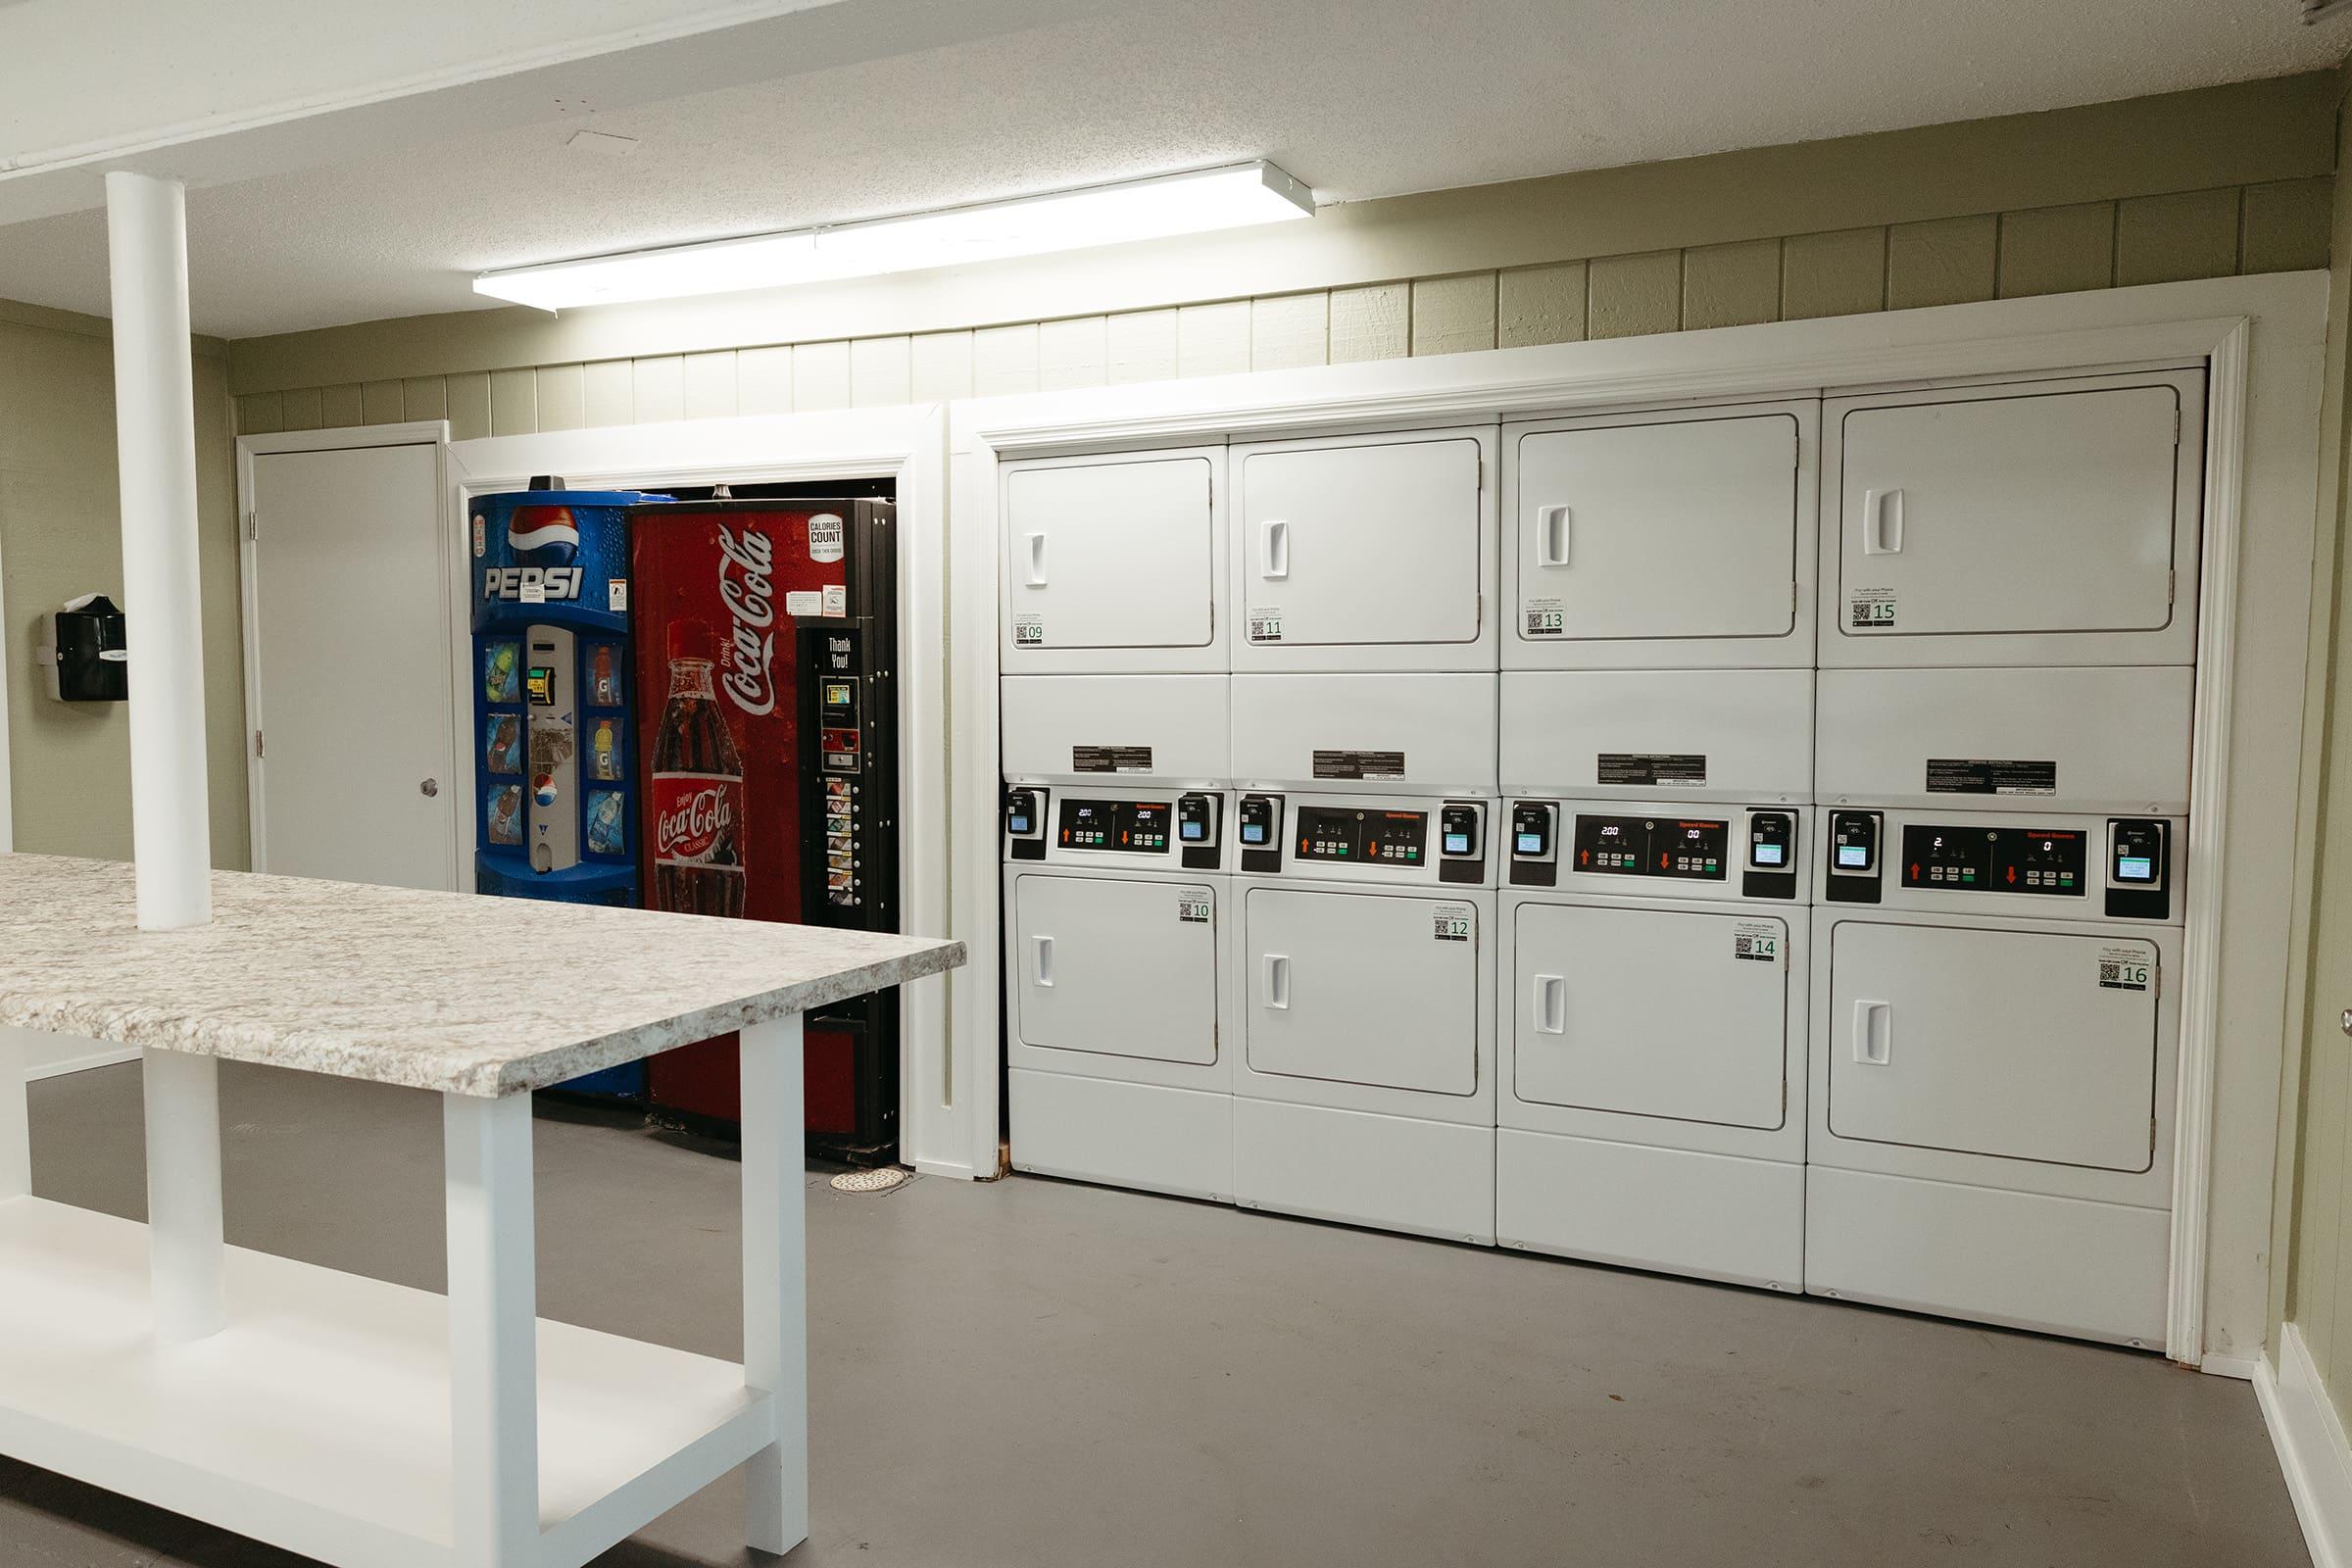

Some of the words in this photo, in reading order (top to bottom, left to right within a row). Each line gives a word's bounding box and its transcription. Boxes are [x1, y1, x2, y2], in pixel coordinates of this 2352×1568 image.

[810, 521, 841, 531] CALORIES
[810, 531, 841, 543] COUNT
[484, 567, 583, 599] PEPSI
[1874, 604, 1894, 618] 15
[717, 523, 775, 715] Coca-Cola
[1544, 613, 1562, 627] 13
[1029, 626, 1043, 638] 09
[1266, 621, 1282, 634] 11
[829, 637, 851, 652] Thank
[720, 638, 731, 667] Drink!
[831, 654, 848, 668] You!
[599, 679, 608, 692] G
[599, 753, 608, 764] G
[676, 792, 693, 808] Enjoy
[658, 784, 731, 854] Coca-Cola
[2043, 841, 2052, 851] 0
[1194, 905, 1208, 916] 10
[1451, 921, 1468, 934] 12
[1755, 940, 1775, 955] 14
[2124, 966, 2147, 983] 16
